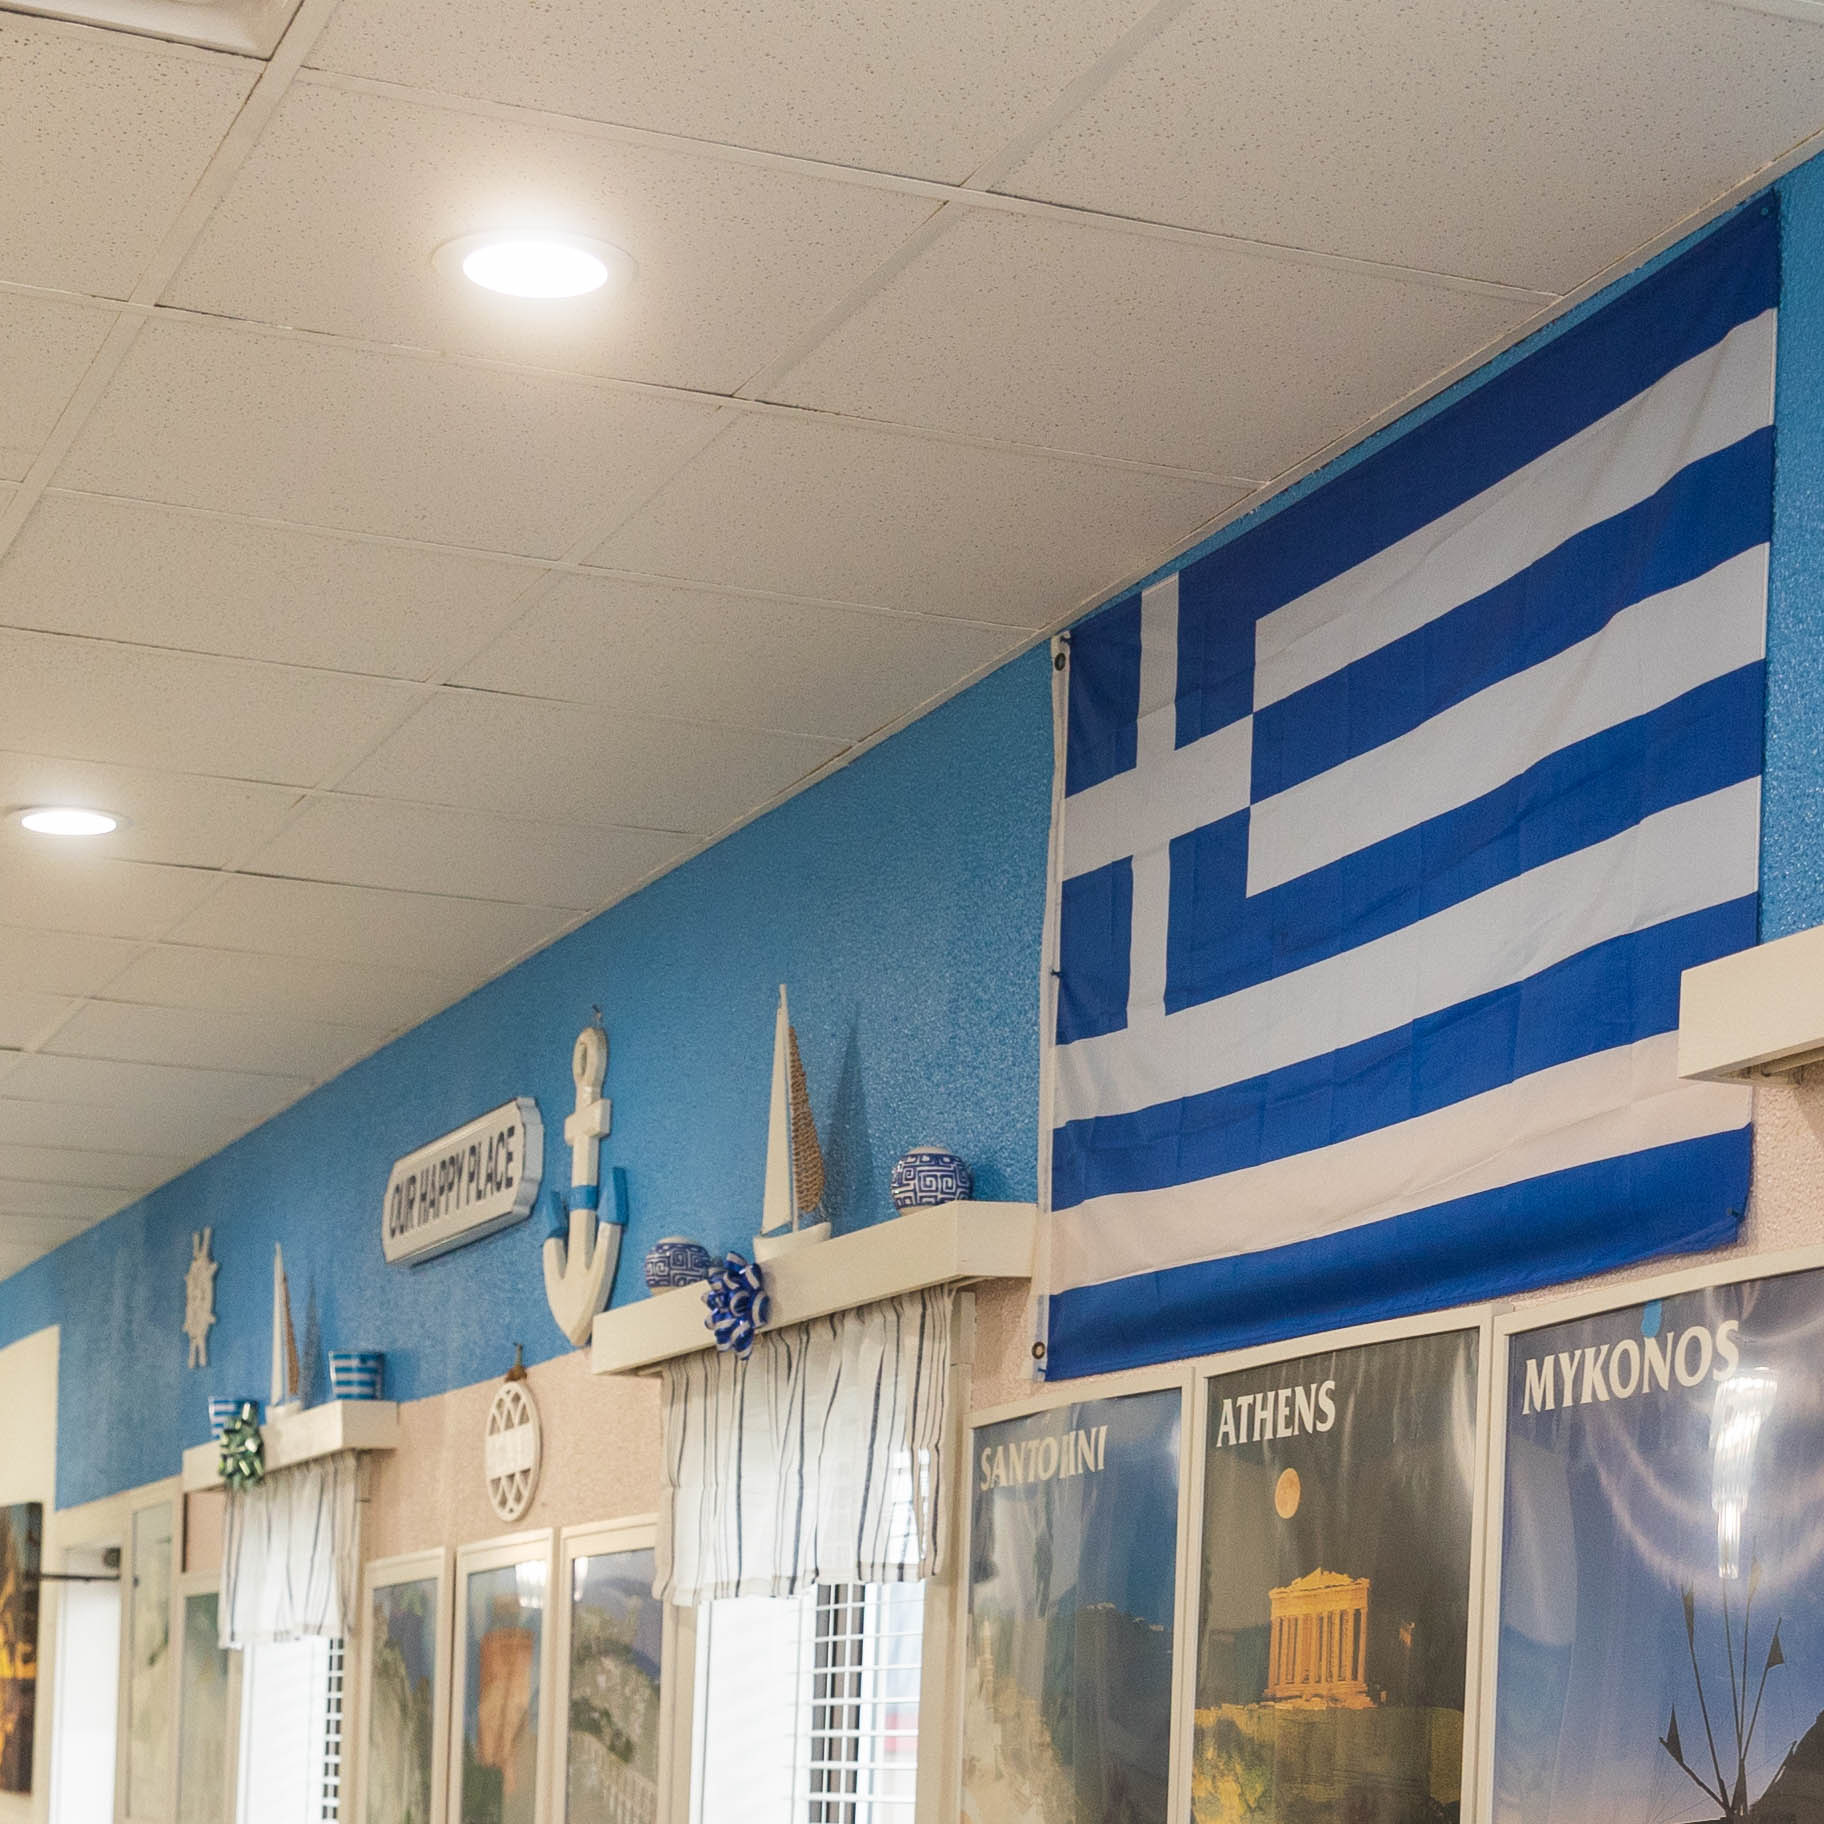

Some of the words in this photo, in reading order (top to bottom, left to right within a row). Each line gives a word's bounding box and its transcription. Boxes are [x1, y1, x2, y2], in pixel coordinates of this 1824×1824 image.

[389, 1175, 417, 1239] OUR
[416, 1149, 466, 1228] HAPPY
[465, 1125, 515, 1206] PLACE
[1216, 1380, 1336, 1447] ATHENS
[1522, 1319, 1739, 1415] MYKONOS
